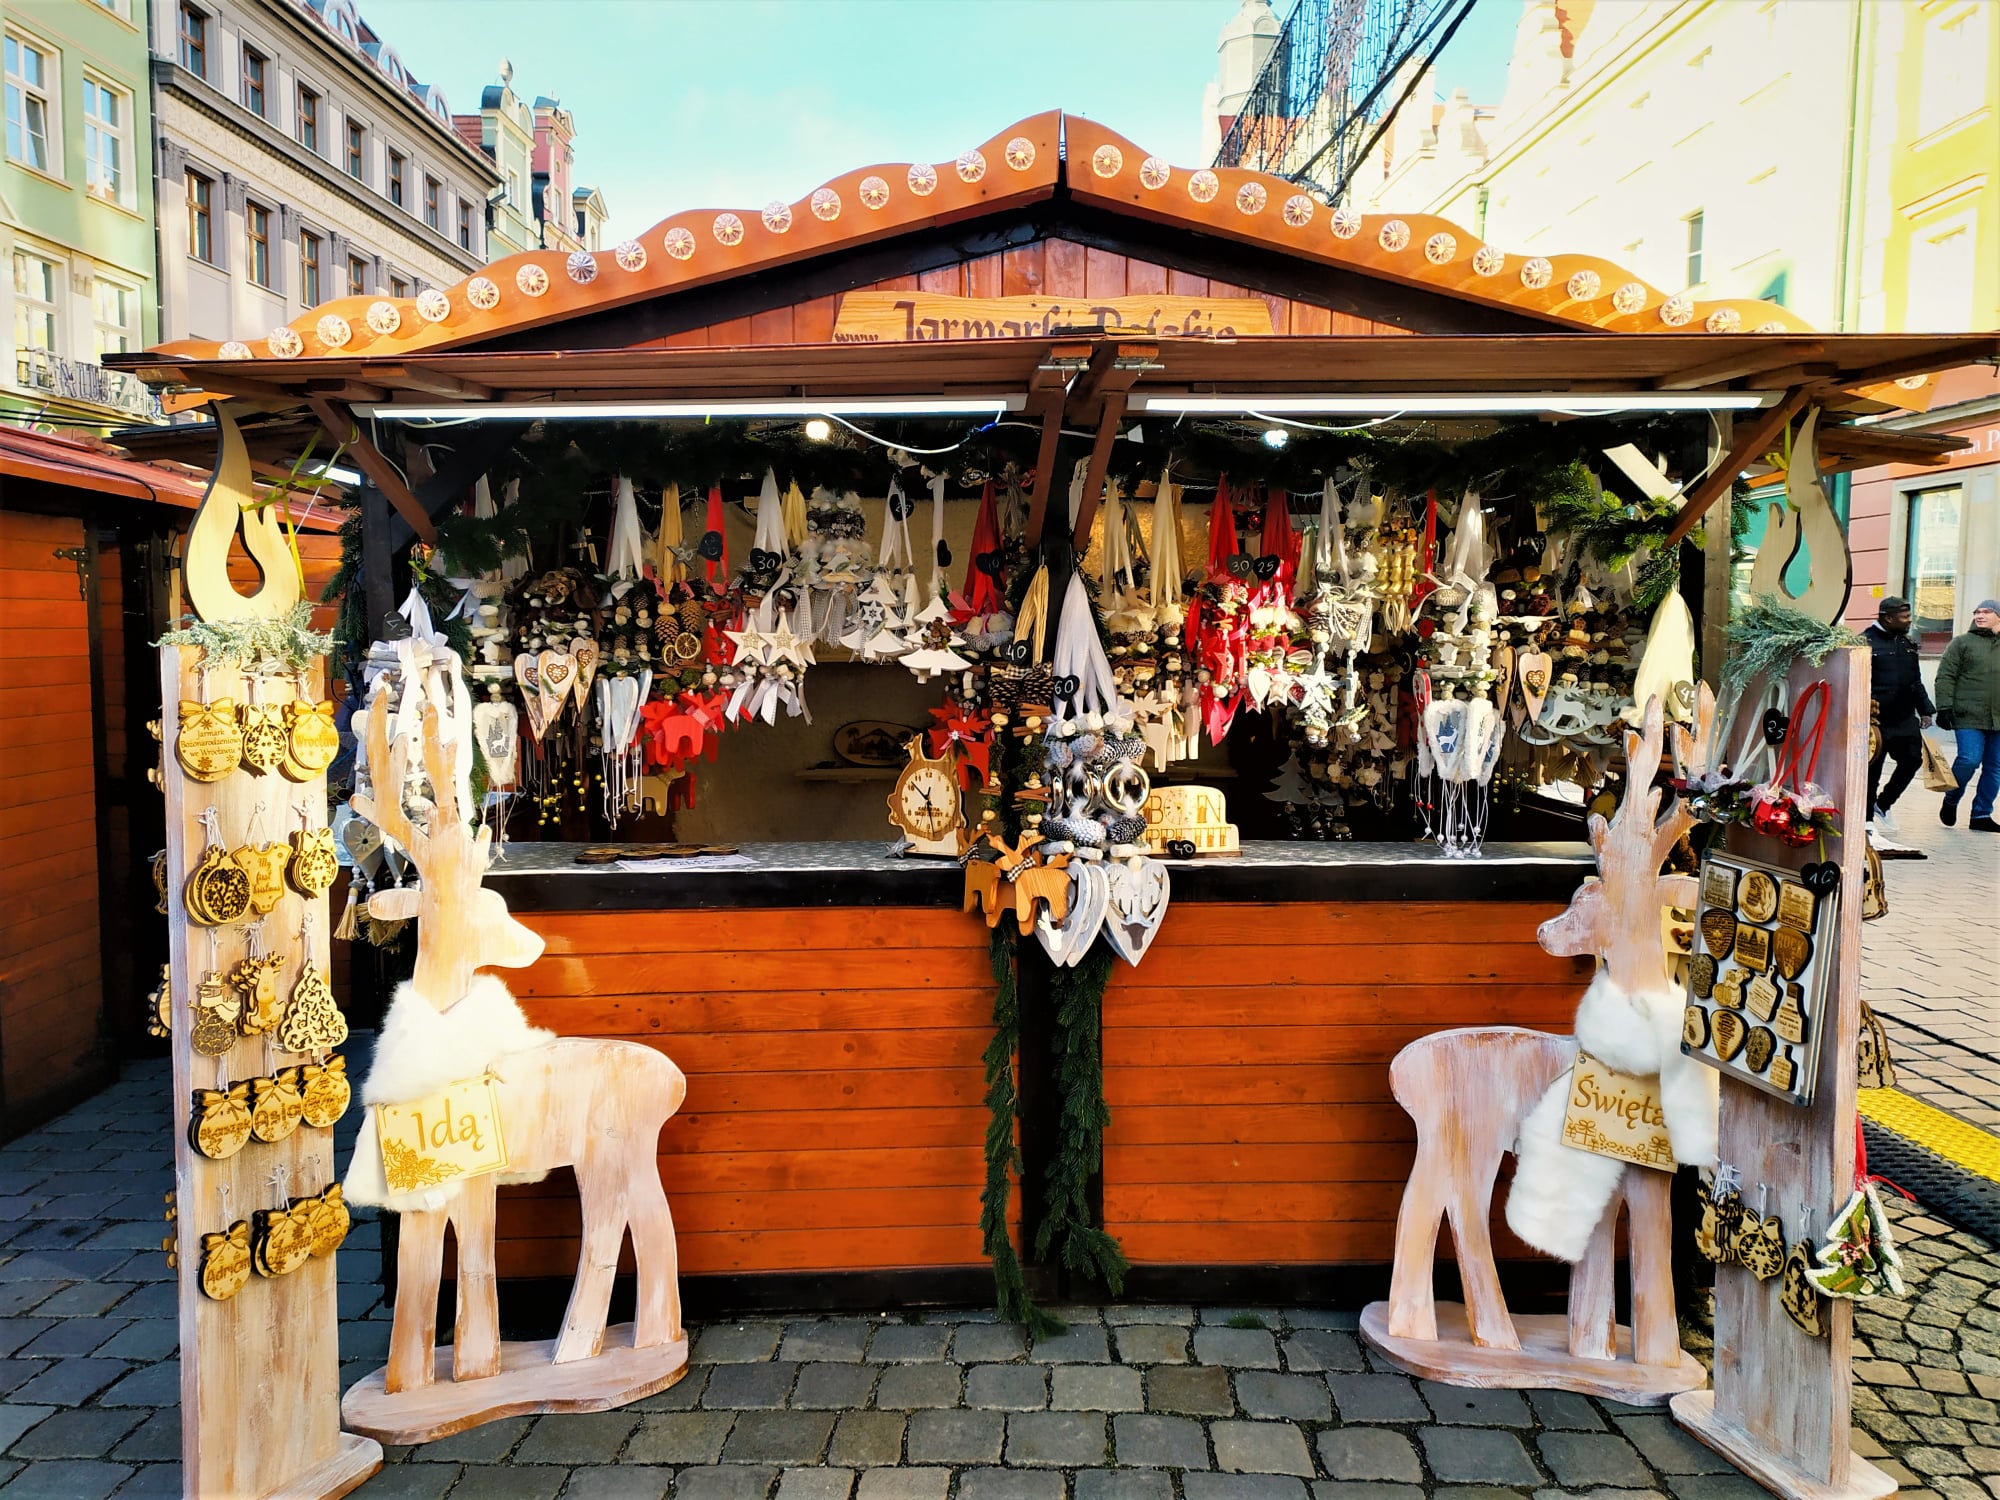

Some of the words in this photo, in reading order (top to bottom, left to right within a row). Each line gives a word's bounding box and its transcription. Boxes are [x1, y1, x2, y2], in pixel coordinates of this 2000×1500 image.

[756, 555, 776, 570] 30
[1232, 560, 1250, 573] 30
[1257, 560, 1275, 573] 25
[1005, 643, 1027, 660] 40
[1054, 679, 1074, 695] 60
[1767, 720, 1788, 740] 25
[1174, 842, 1194, 856] 40
[1776, 934, 1804, 957] ROCK
[1573, 1074, 1668, 1130] Święta
[254, 1103, 302, 1130] Asia
[205, 1257, 251, 1287] Adrian
